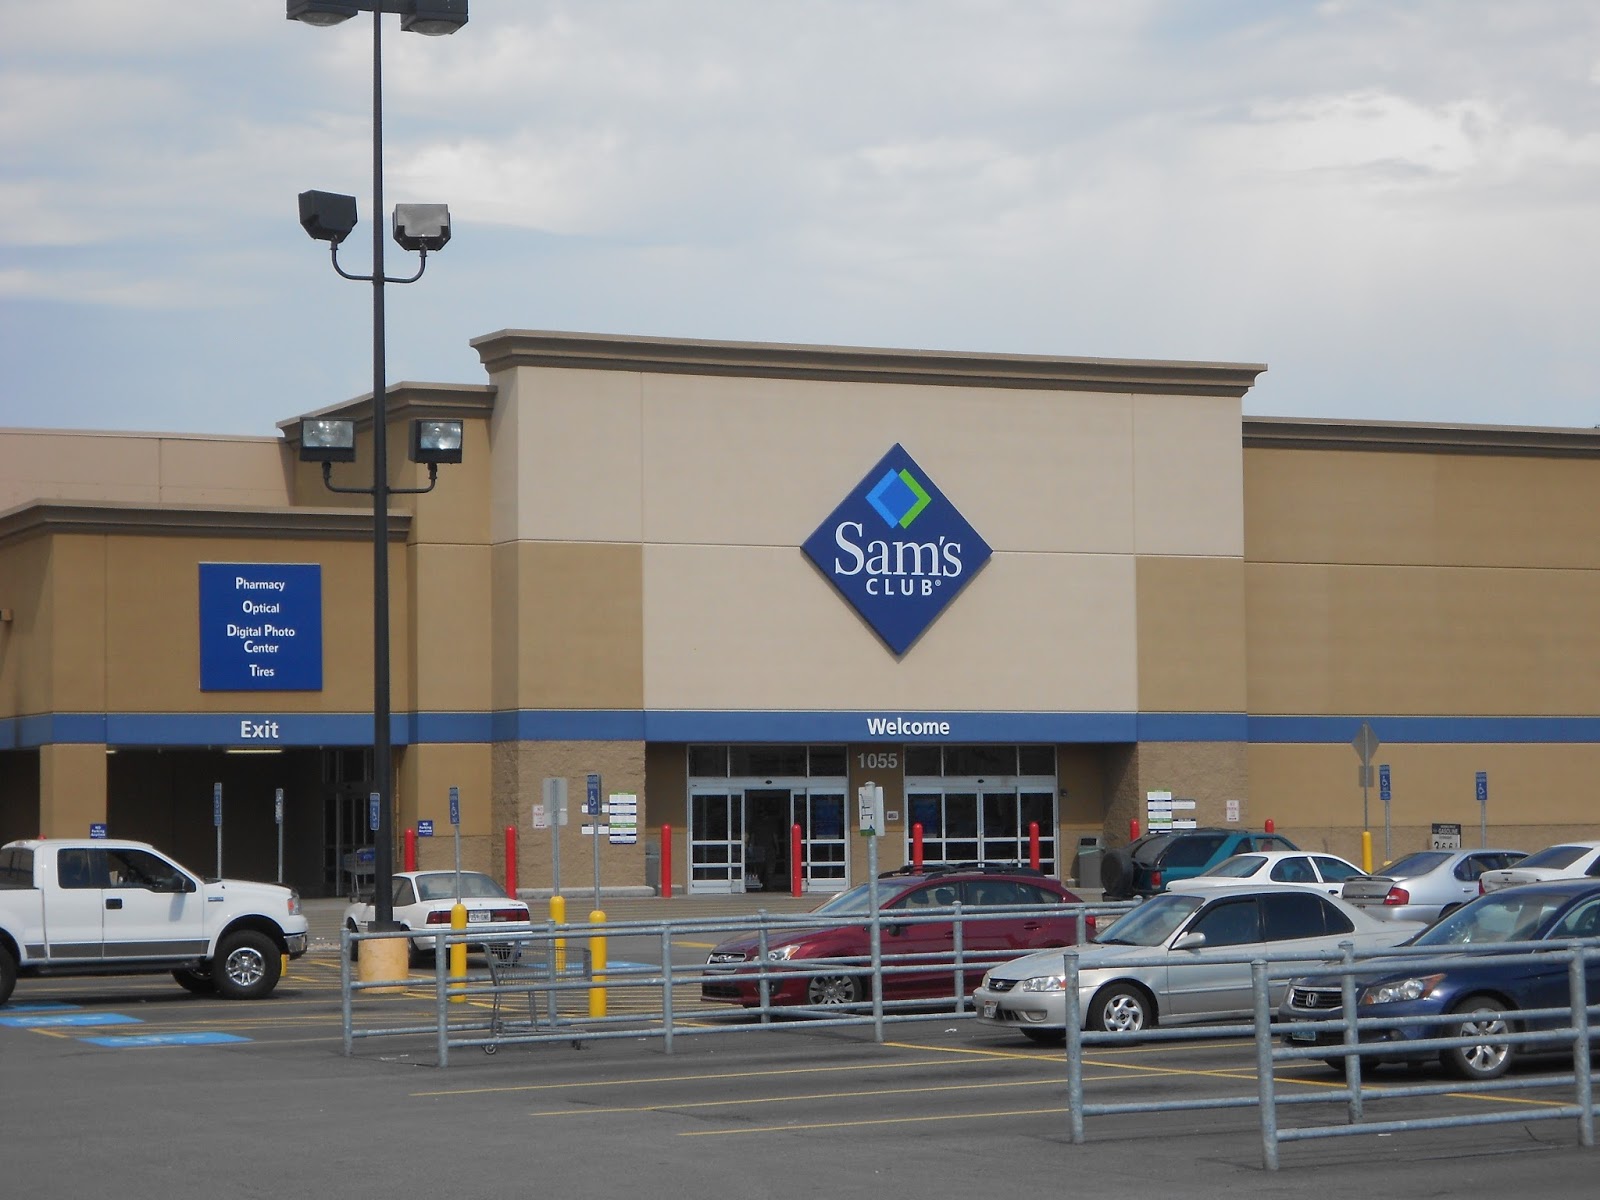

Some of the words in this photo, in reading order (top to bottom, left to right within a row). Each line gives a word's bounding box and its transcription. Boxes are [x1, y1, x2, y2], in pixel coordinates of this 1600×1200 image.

[834, 521, 963, 577] Sam's
[235, 576, 285, 592] Pharmacy
[242, 600, 280, 615] Optical
[226, 624, 262, 639] Digital
[264, 624, 296, 637] Photo
[243, 640, 279, 653] Center
[248, 664, 275, 677] Tires
[240, 720, 279, 739] Exit
[866, 717, 950, 735] Welcome
[857, 753, 898, 769] 1055
